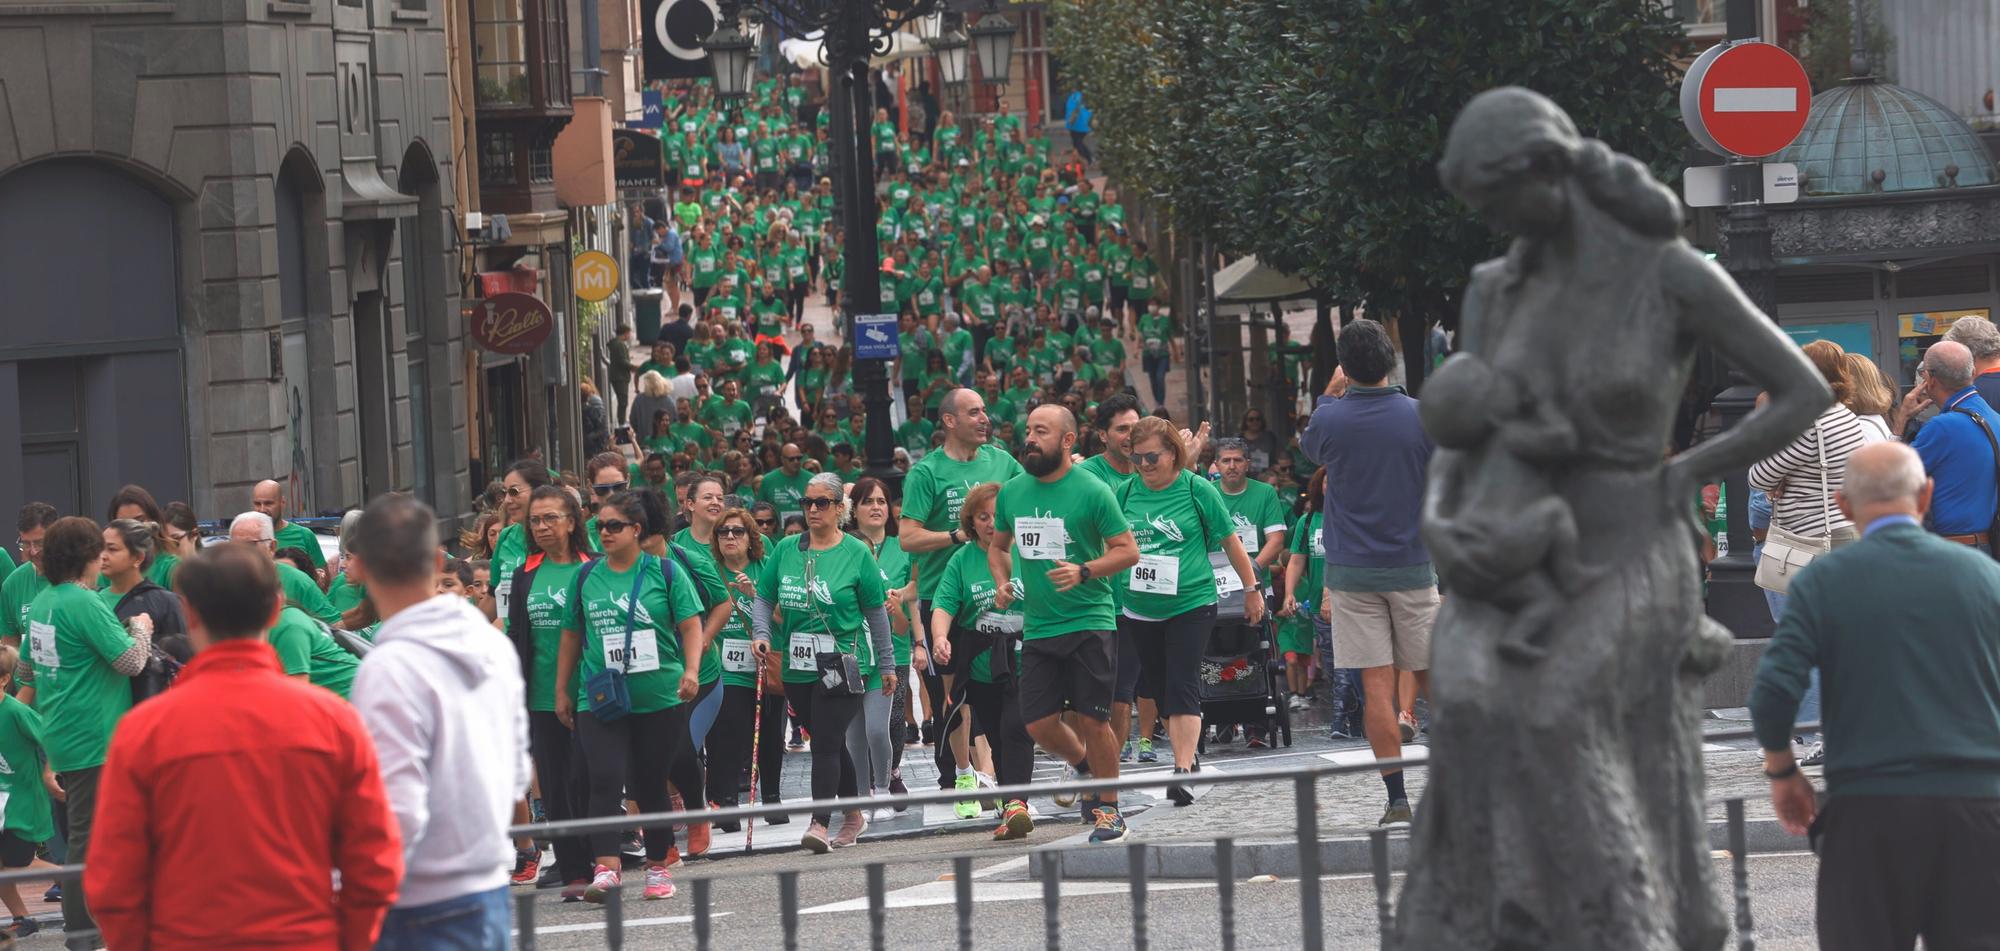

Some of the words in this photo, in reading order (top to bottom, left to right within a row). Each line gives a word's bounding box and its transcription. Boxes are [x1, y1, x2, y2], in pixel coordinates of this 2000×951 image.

[481, 307, 545, 342] Rialto
[946, 490, 957, 498] En
[1020, 532, 1041, 546] 197
[1135, 566, 1156, 581] 964
[781, 576, 792, 584] En
[971, 585, 982, 593] En
[779, 591, 802, 600] contra
[588, 601, 598, 610] En
[607, 646, 637, 662] 101
[727, 650, 745, 662] 421
[792, 646, 812, 659] 484
